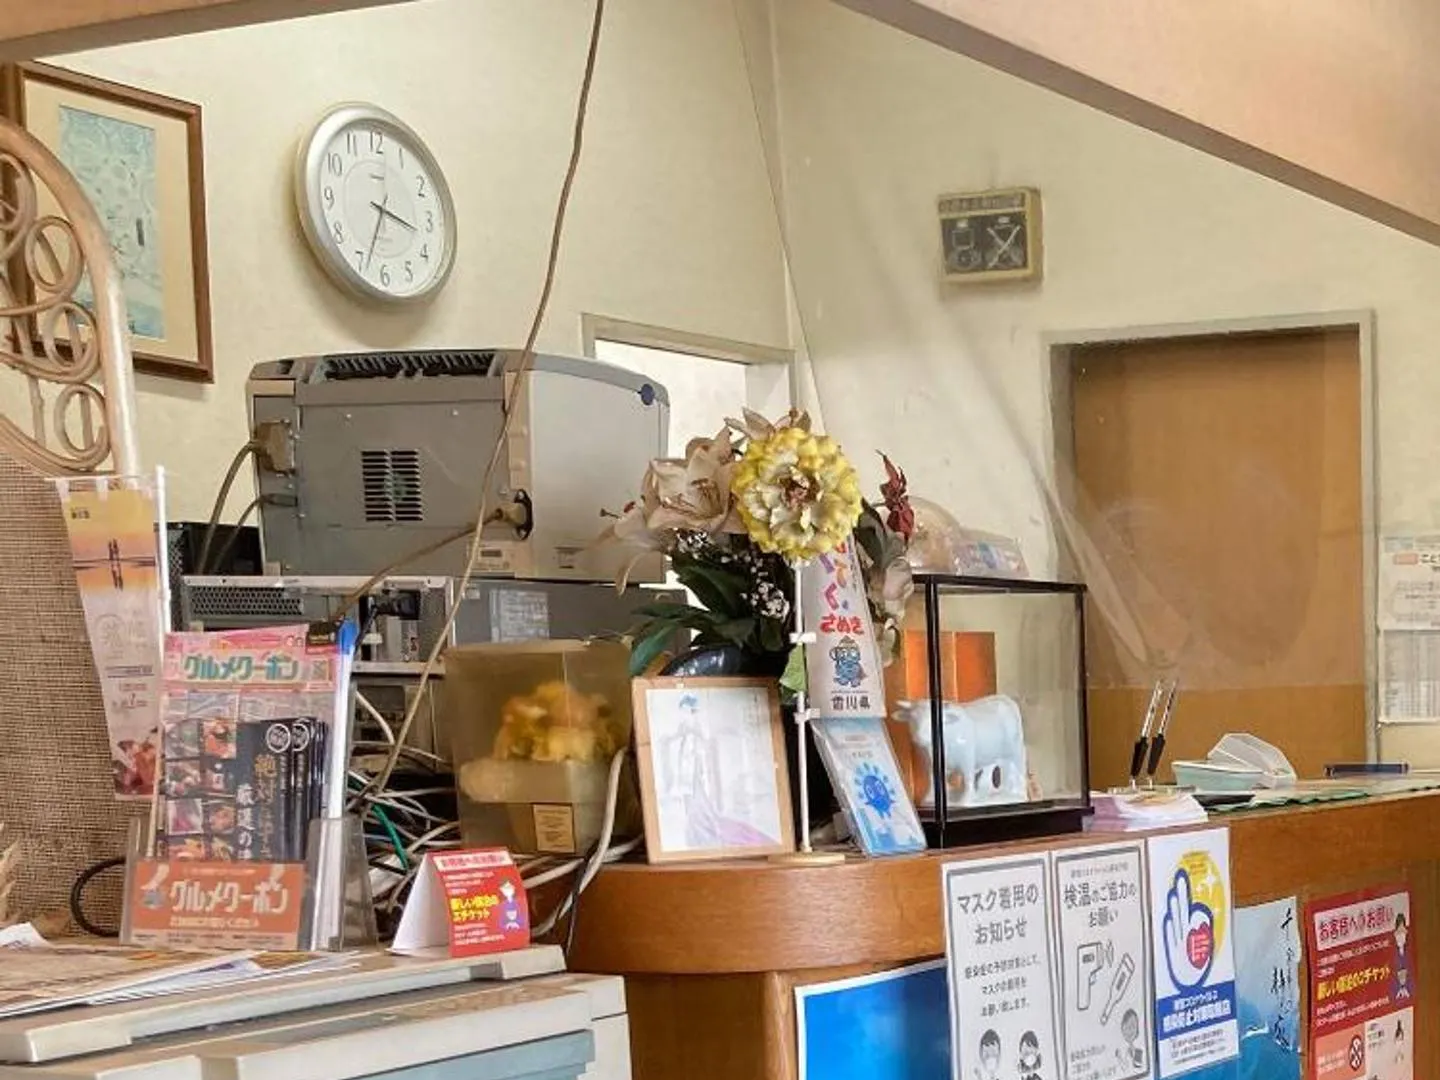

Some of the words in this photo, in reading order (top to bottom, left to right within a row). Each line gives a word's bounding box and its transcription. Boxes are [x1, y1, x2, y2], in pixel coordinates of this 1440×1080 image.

[347, 132, 358, 156] 11
[370, 129, 384, 155] 12
[328, 152, 342, 176] 10
[324, 186, 334, 210] 9
[416, 176, 425, 197] 2
[334, 222, 343, 244] 8
[426, 211, 433, 232] 3
[355, 250, 364, 273] 7
[420, 244, 429, 262] 4
[380, 264, 390, 287] 6
[404, 261, 413, 282] 5
[820, 614, 864, 634] さぬき
[185, 653, 300, 681] グルメクーポン
[831, 695, 871, 710] 香川県
[169, 879, 288, 914] グルメクーポン
[957, 883, 1039, 914] マスク着用の
[1064, 880, 1136, 909] 検温のご協力の
[1089, 906, 1118, 928] お願い
[974, 917, 1027, 945] お知らせ
